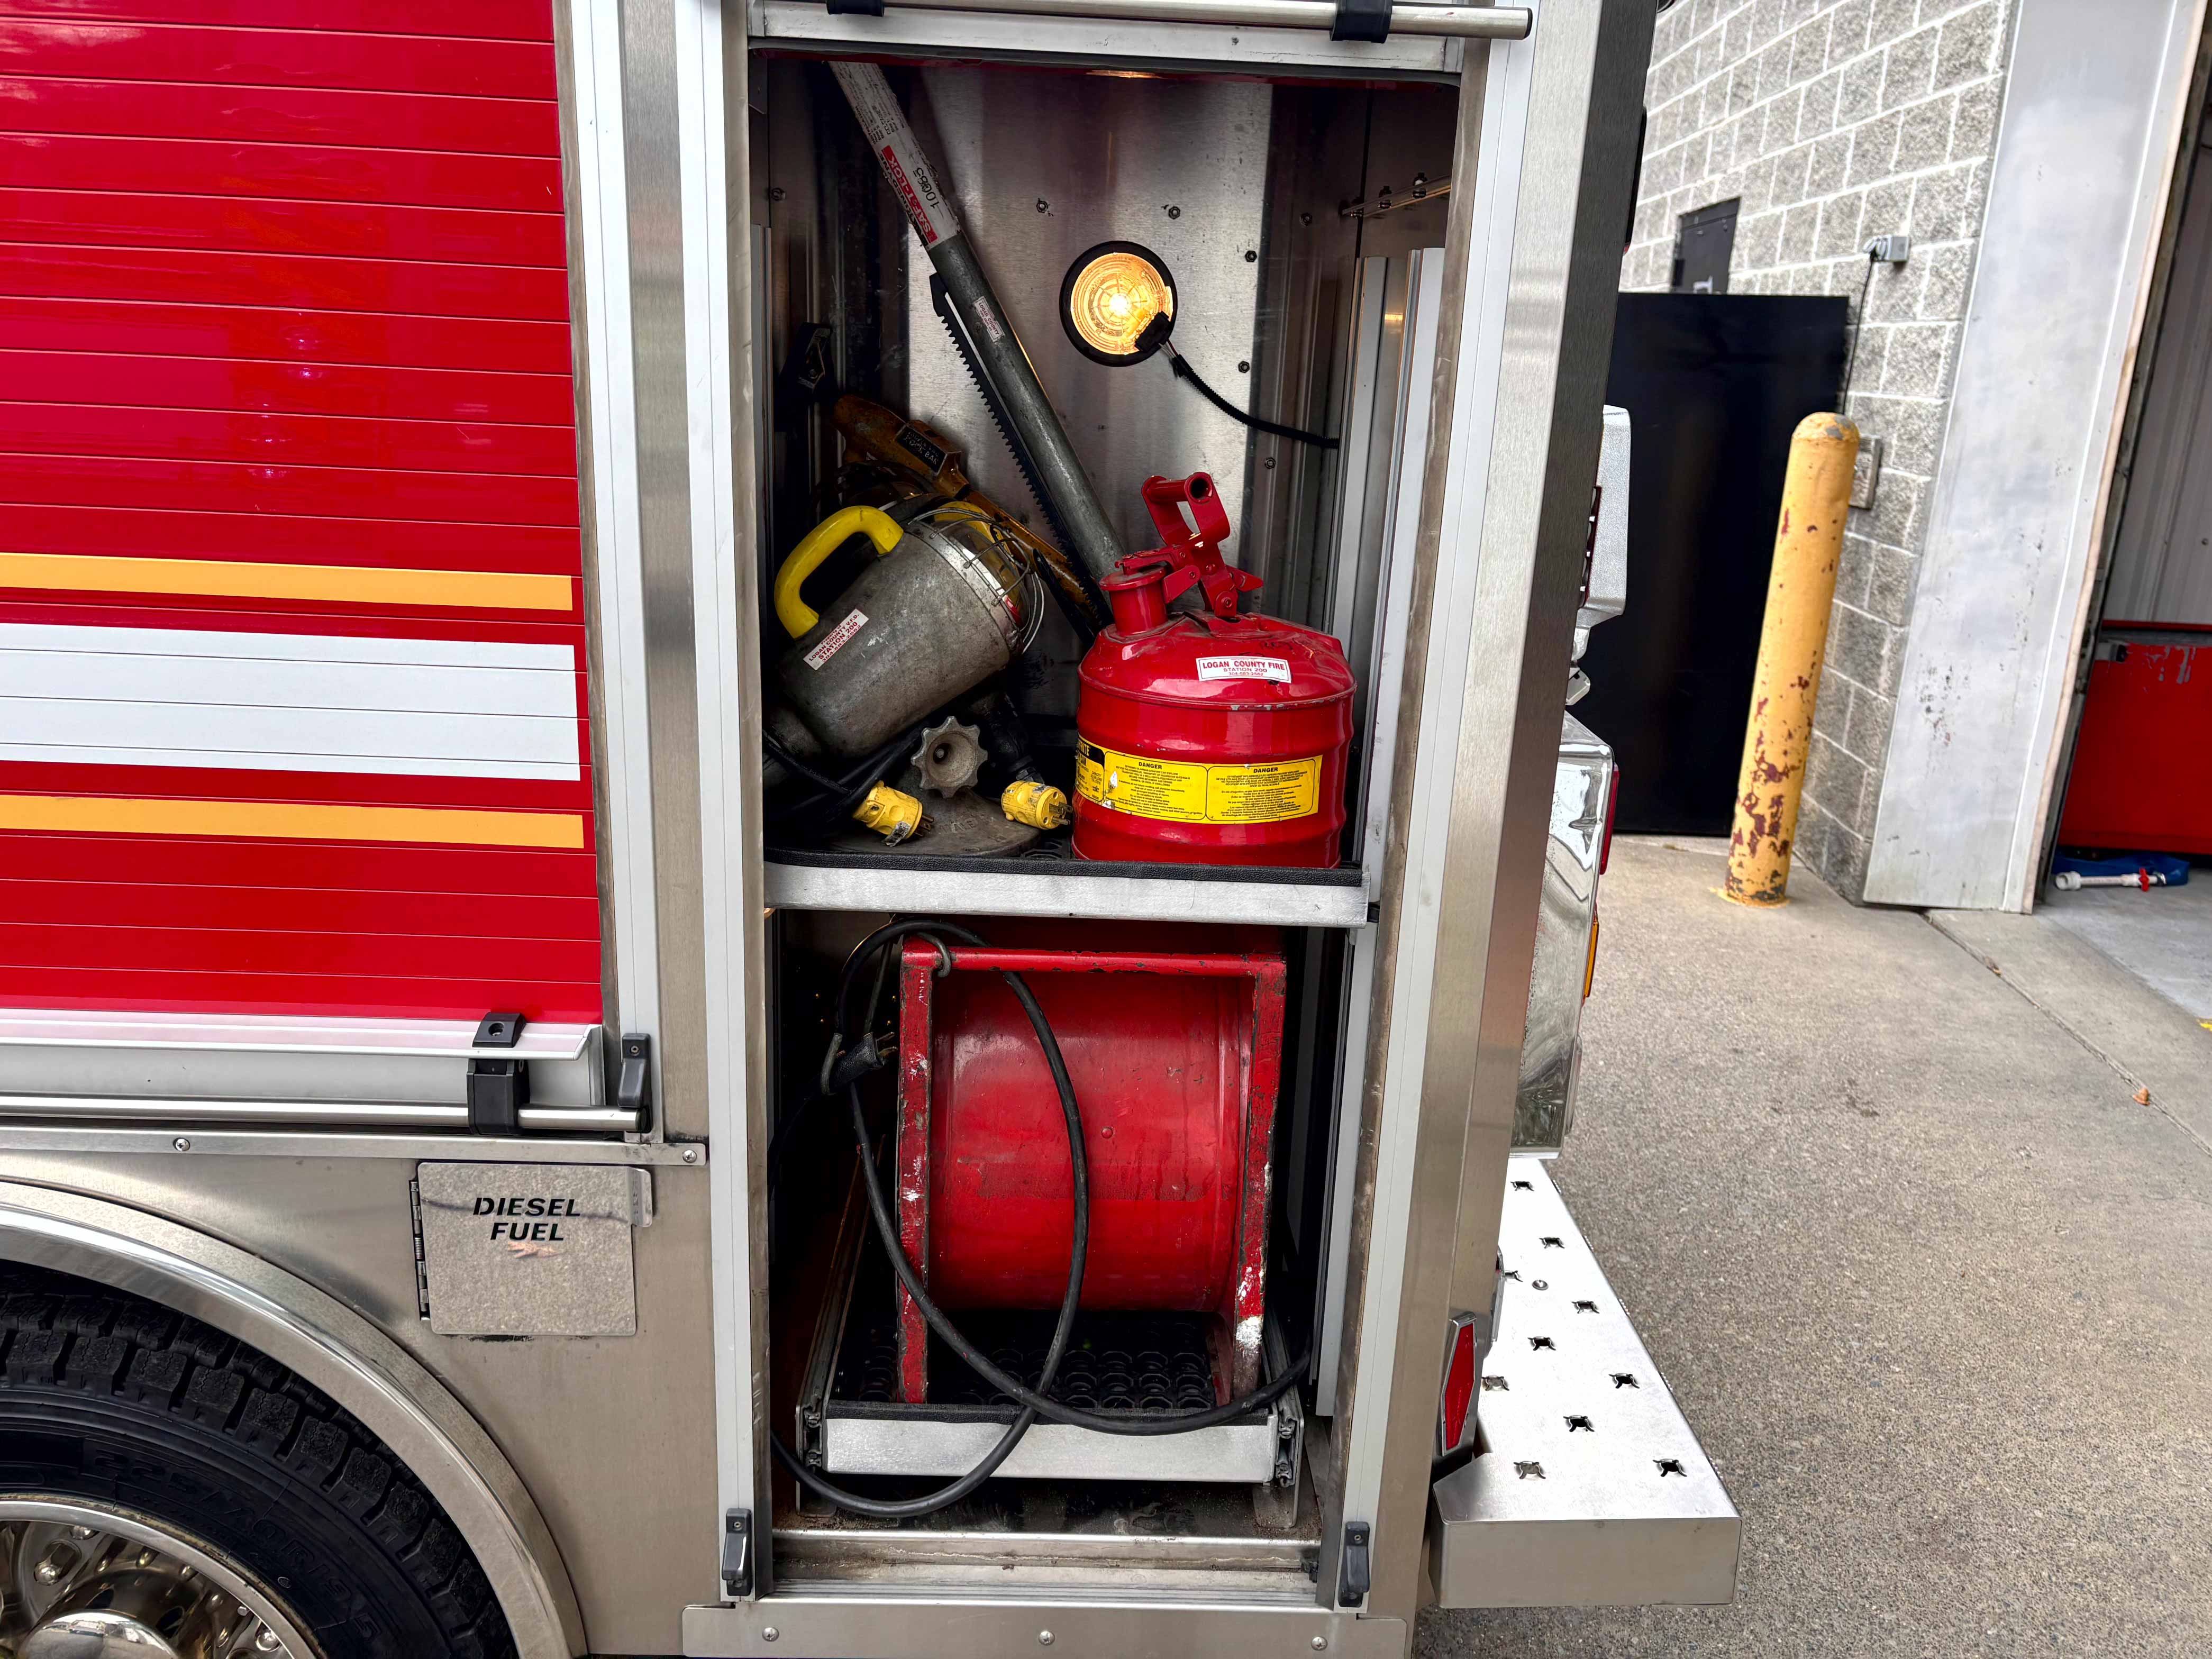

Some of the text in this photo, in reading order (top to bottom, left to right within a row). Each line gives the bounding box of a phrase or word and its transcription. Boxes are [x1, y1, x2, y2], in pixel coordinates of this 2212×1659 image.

[808, 644, 826, 661] LOGAN
[826, 626, 846, 645] COUNTY
[818, 622, 858, 660] STATION 200
[1268, 662, 1285, 670] FIRE
[1139, 761, 1162, 770] DANGER
[473, 1197, 580, 1217] DIESEL
[490, 1222, 564, 1241] FUEL
